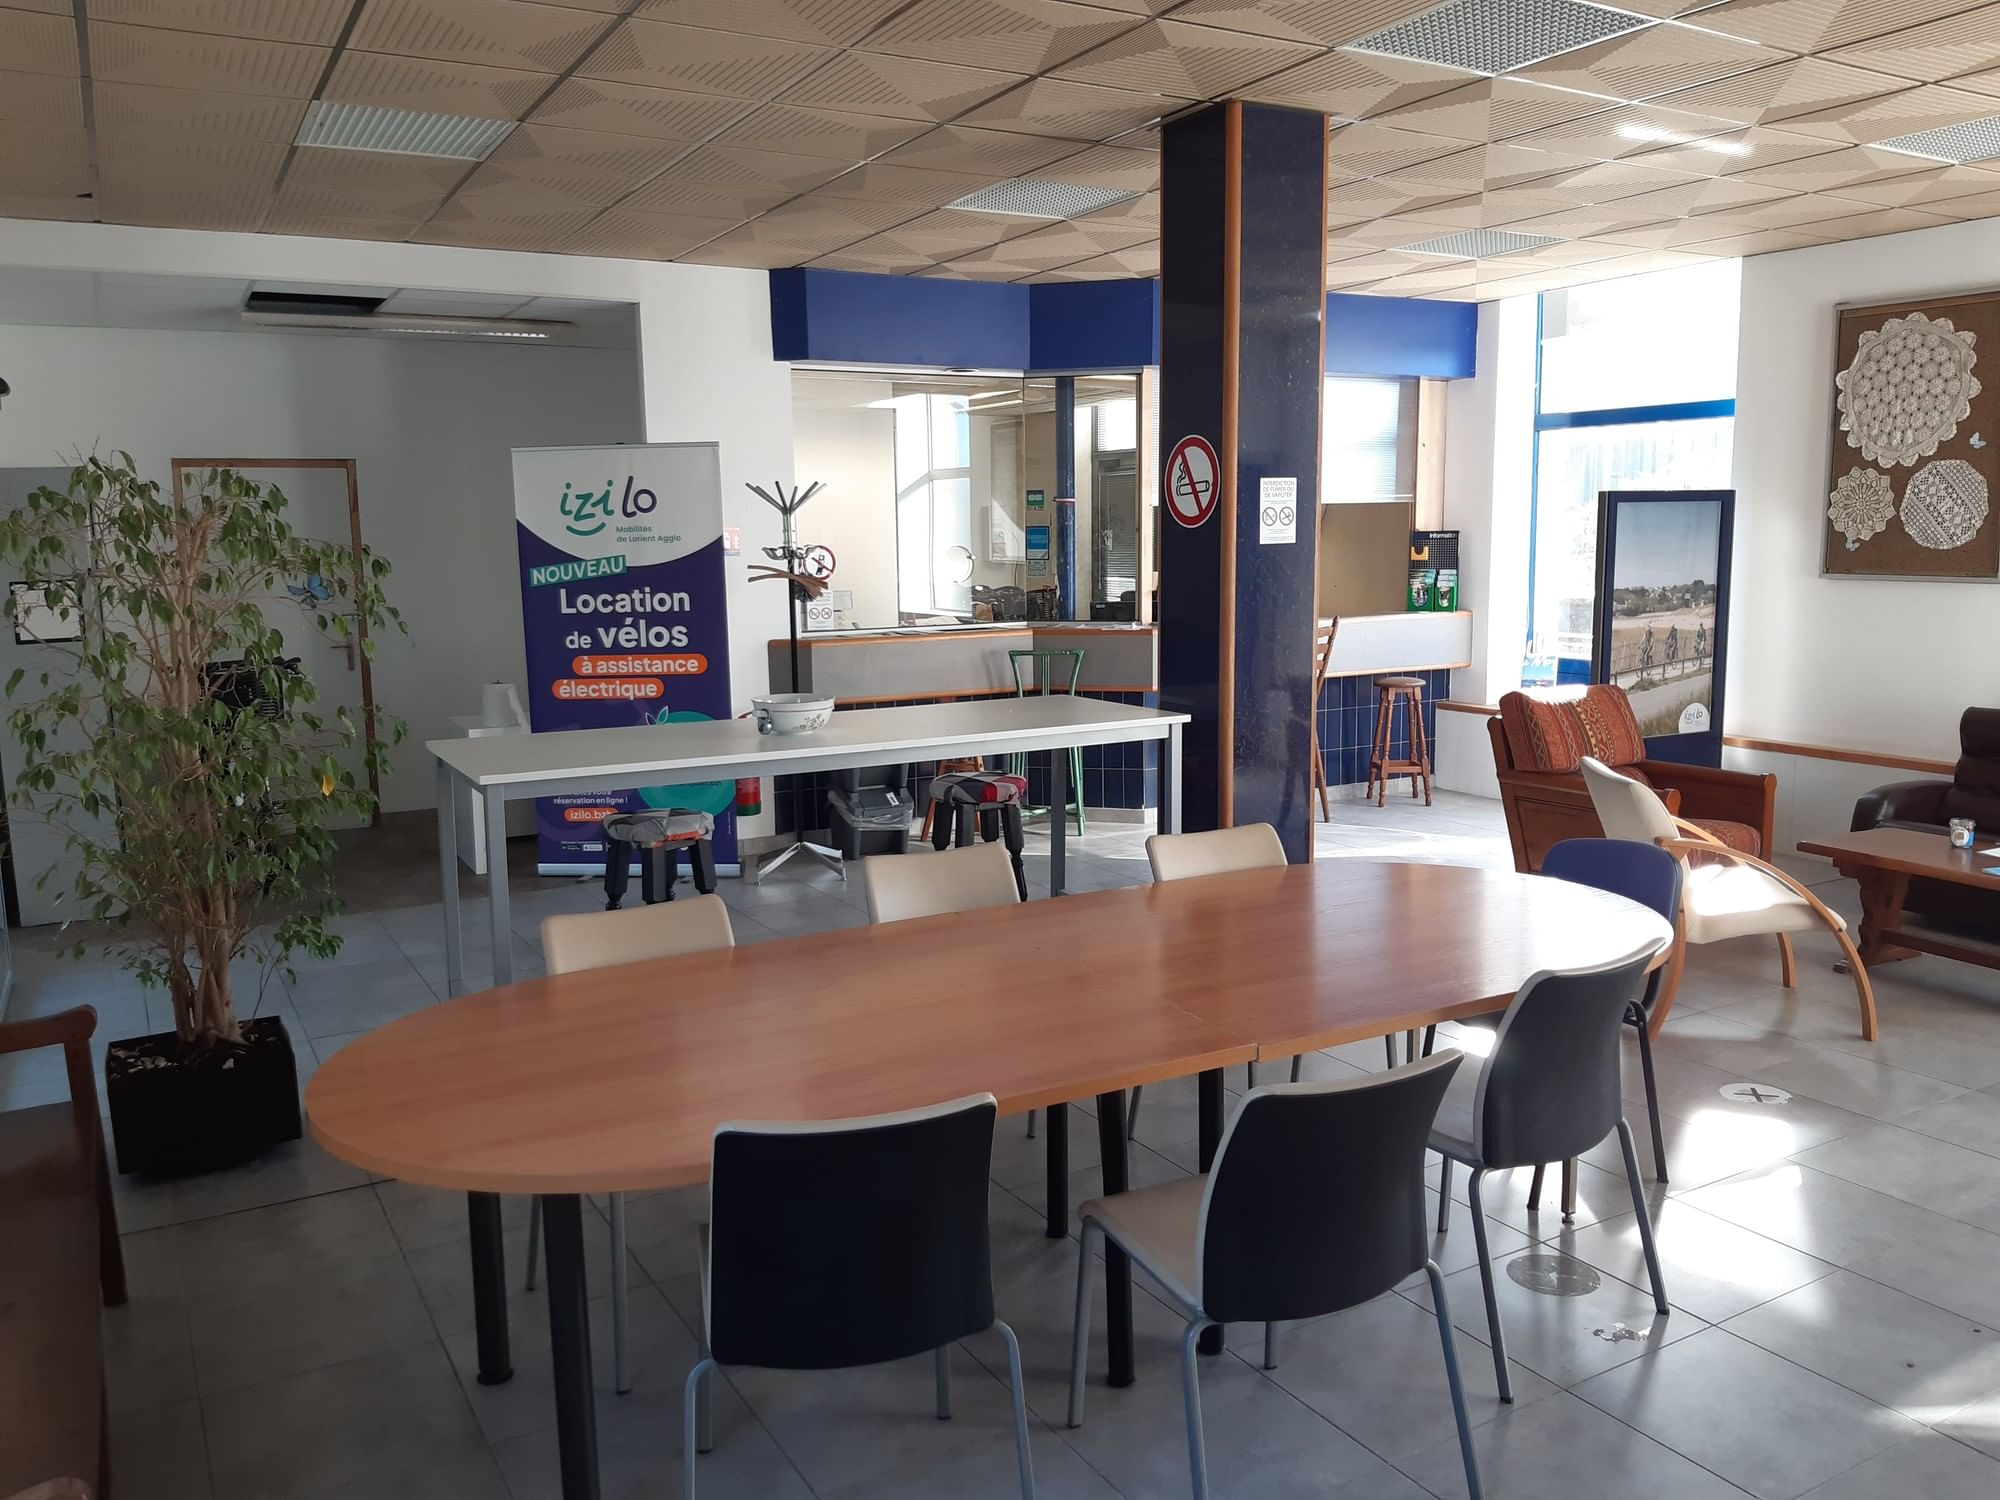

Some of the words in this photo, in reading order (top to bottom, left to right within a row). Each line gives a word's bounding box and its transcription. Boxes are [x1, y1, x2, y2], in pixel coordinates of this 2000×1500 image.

[616, 535, 627, 543] de
[658, 535, 681, 543] Agglo
[533, 556, 624, 584] NOUVEAU
[560, 587, 690, 614] Location
[565, 631, 592, 649] de
[597, 617, 689, 648] vélos
[582, 656, 592, 673] à
[597, 656, 699, 673] assistance
[559, 680, 657, 700] électrique
[606, 797, 624, 805] ligne
